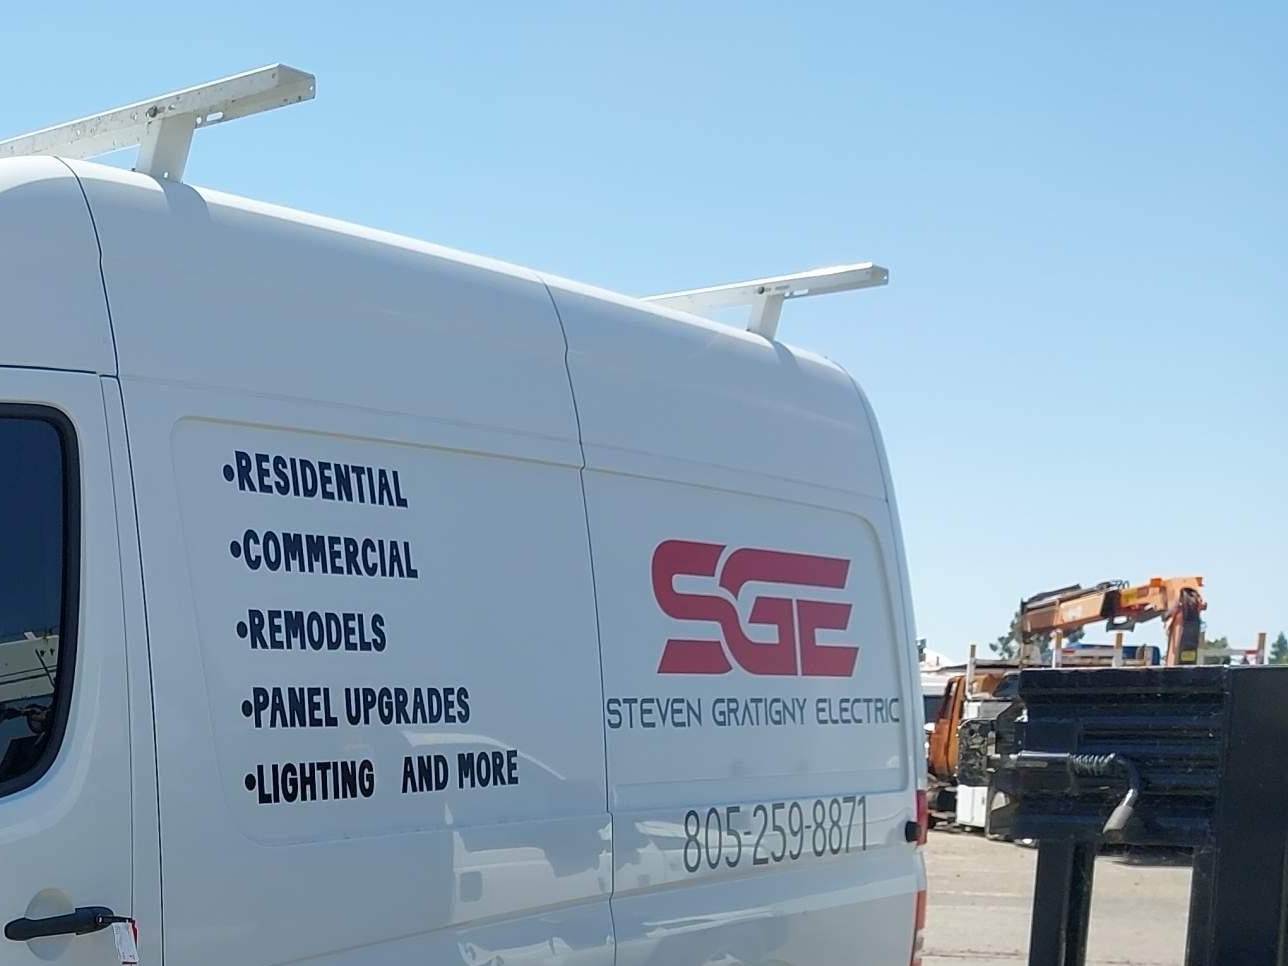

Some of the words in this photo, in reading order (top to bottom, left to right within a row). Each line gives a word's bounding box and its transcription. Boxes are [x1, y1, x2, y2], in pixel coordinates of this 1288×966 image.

[235, 450, 408, 508] RESIDENTIAL
[242, 529, 419, 579] COMMERCIAL
[248, 609, 387, 652] REMODELS
[651, 539, 860, 677] SGE
[252, 687, 339, 729] PANEL
[344, 687, 471, 725] UPGRADES
[607, 698, 703, 728] STEVEN
[712, 698, 806, 726] GRATIGNY
[816, 698, 900, 724] ELECTRIC
[257, 760, 375, 804] LIGHTING
[401, 754, 449, 794] AND
[457, 750, 519, 789] MORE
[683, 796, 868, 873] 805-259-8871
